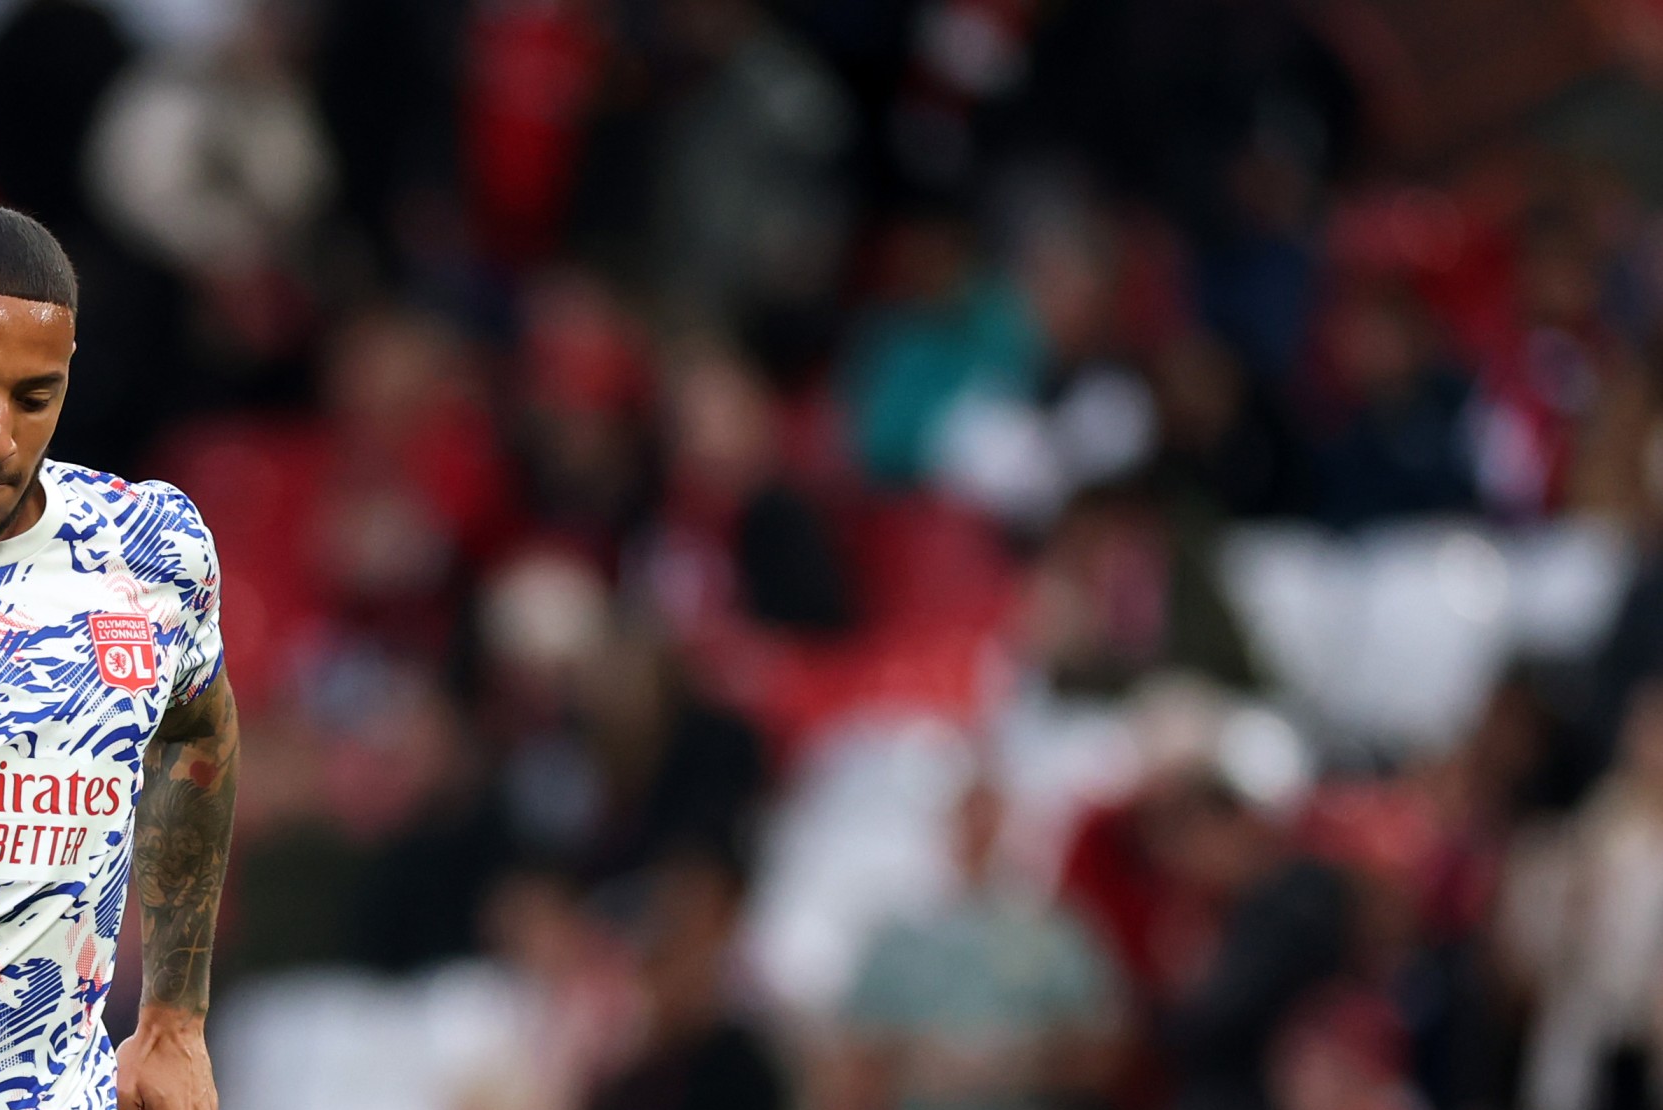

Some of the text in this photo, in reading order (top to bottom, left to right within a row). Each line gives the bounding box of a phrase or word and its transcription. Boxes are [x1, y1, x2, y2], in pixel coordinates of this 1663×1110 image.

[96, 619, 146, 629] OLYMPIQUE
[98, 629, 148, 640] LYONNAIS
[104, 645, 152, 679] OL
